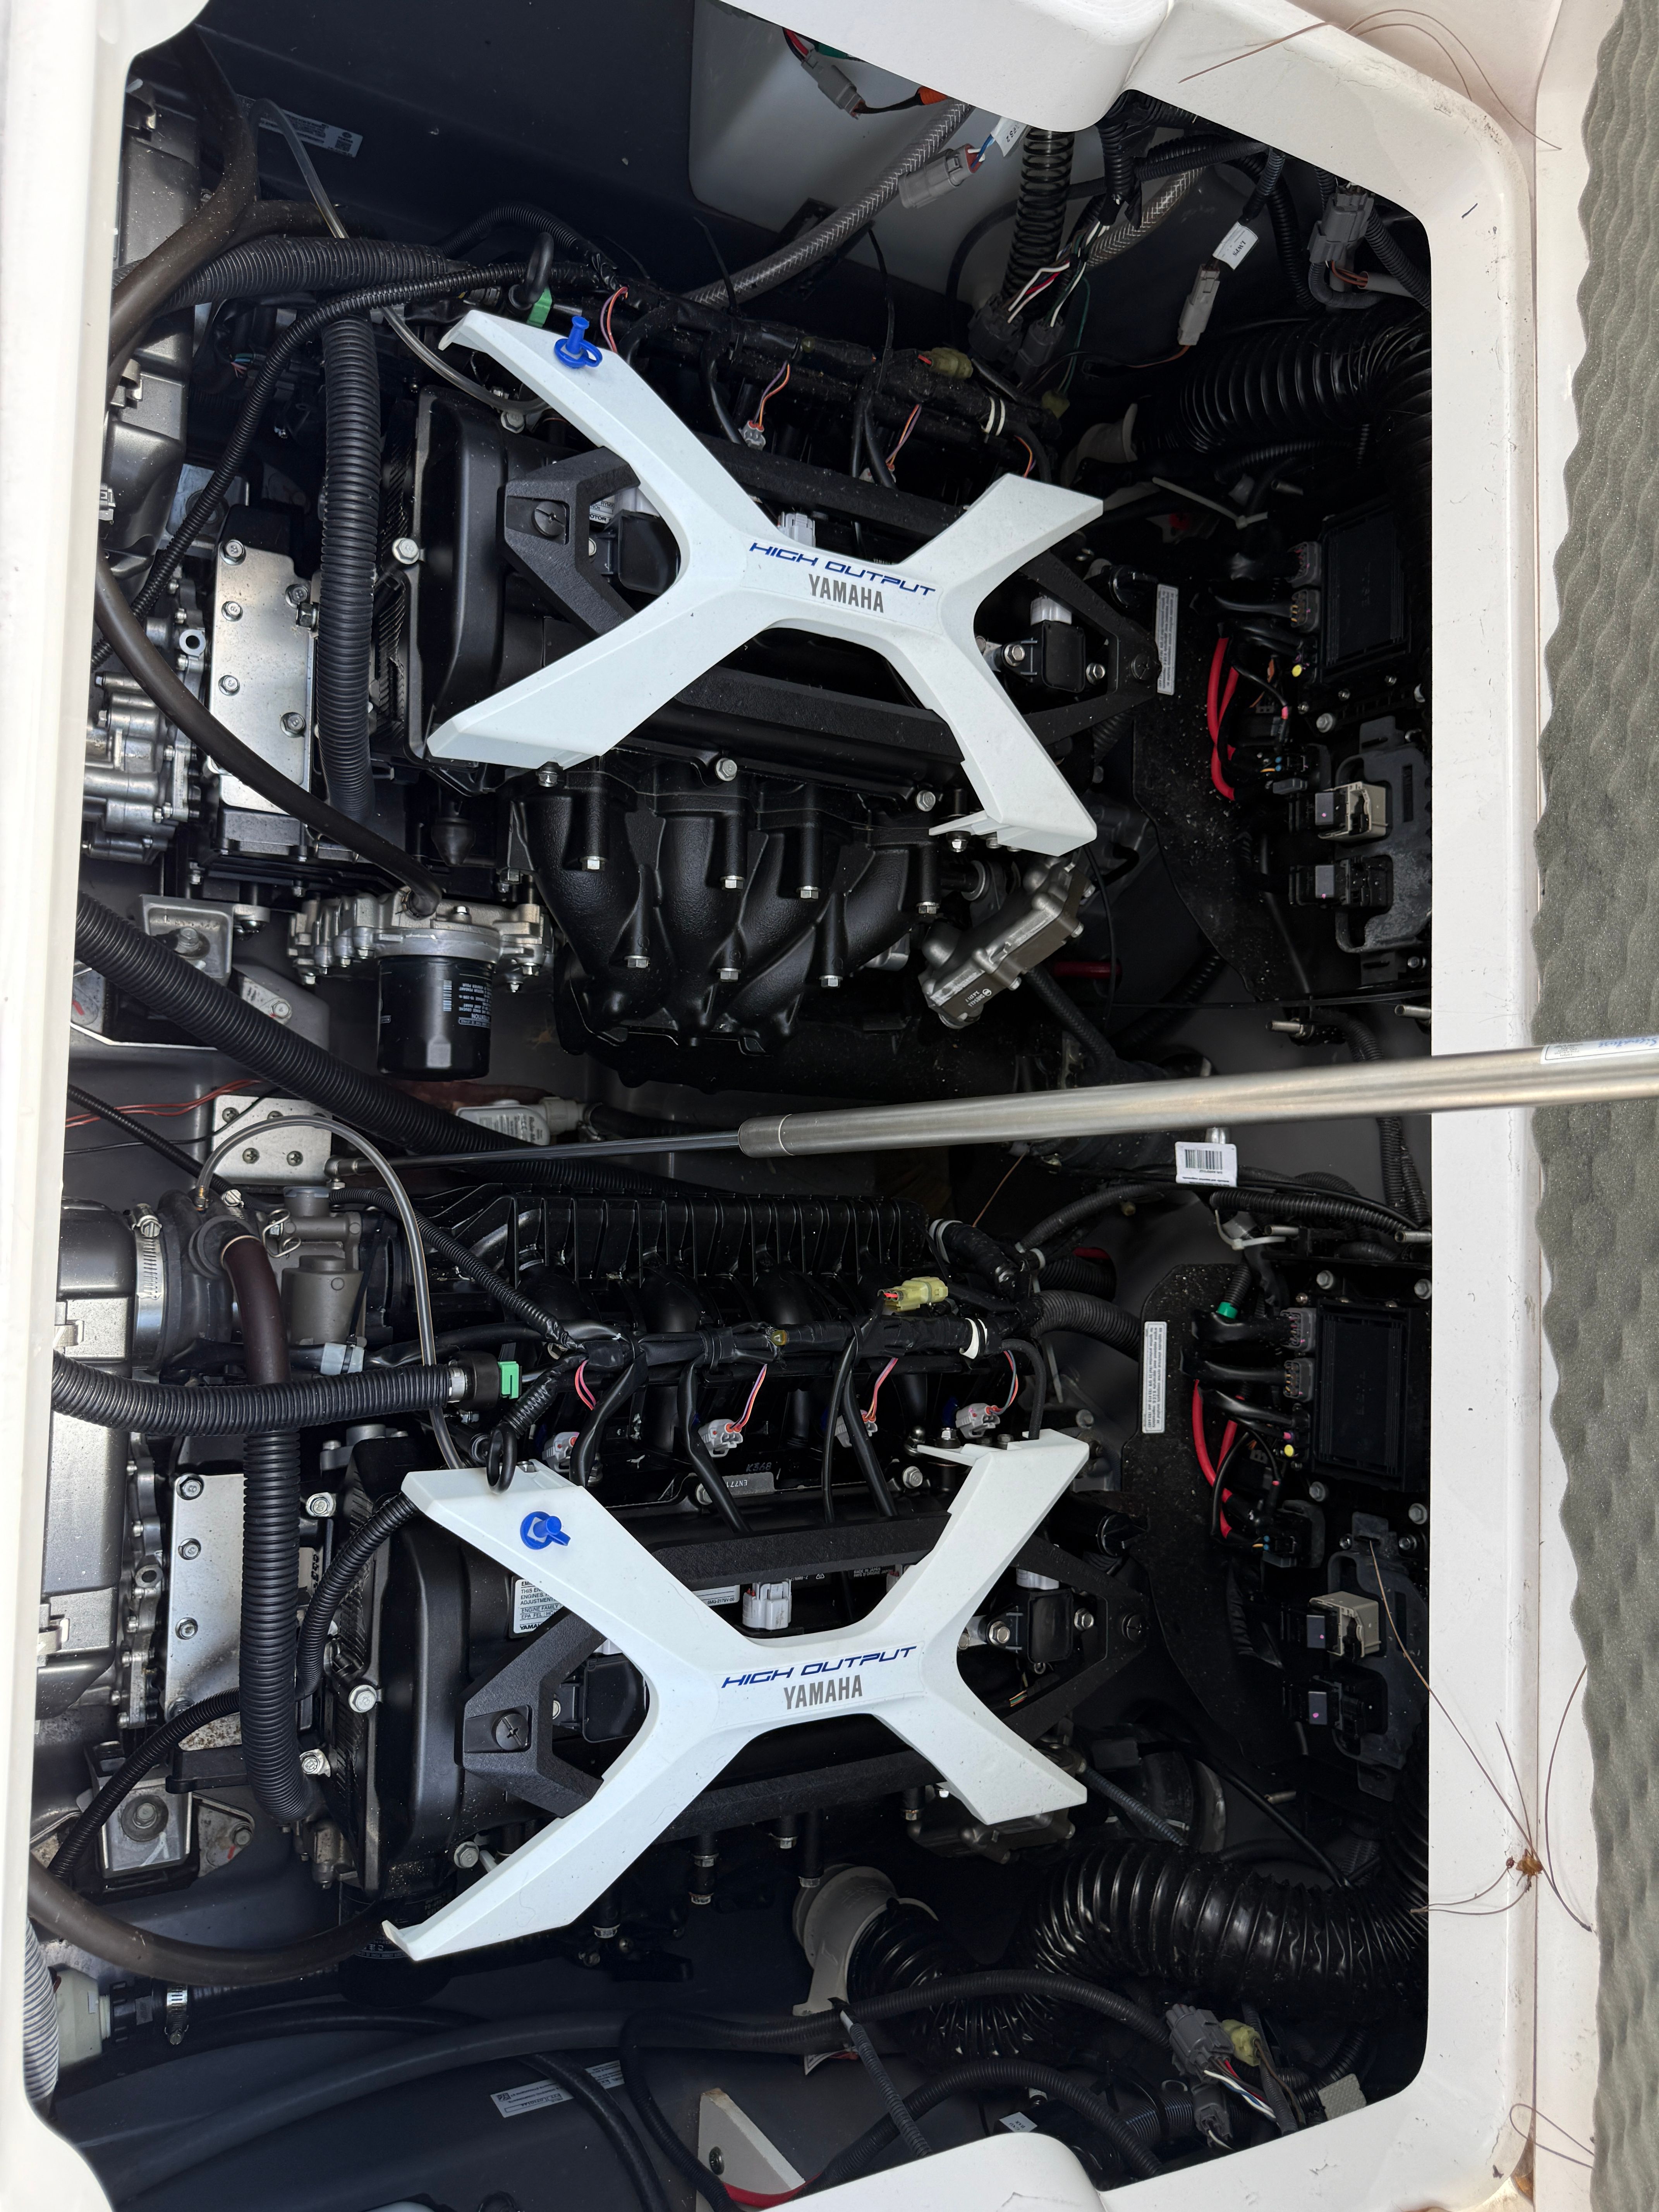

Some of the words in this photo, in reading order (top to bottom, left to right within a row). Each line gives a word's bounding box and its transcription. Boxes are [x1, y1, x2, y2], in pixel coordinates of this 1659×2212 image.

[750, 543, 819, 566] HIGH
[825, 561, 936, 596] OUTPUT
[808, 574, 884, 613] YAMAHA
[721, 1667, 795, 1688] HIGH
[800, 1645, 917, 1676] OUTPUT
[783, 1674, 863, 1710] YAMAHA
